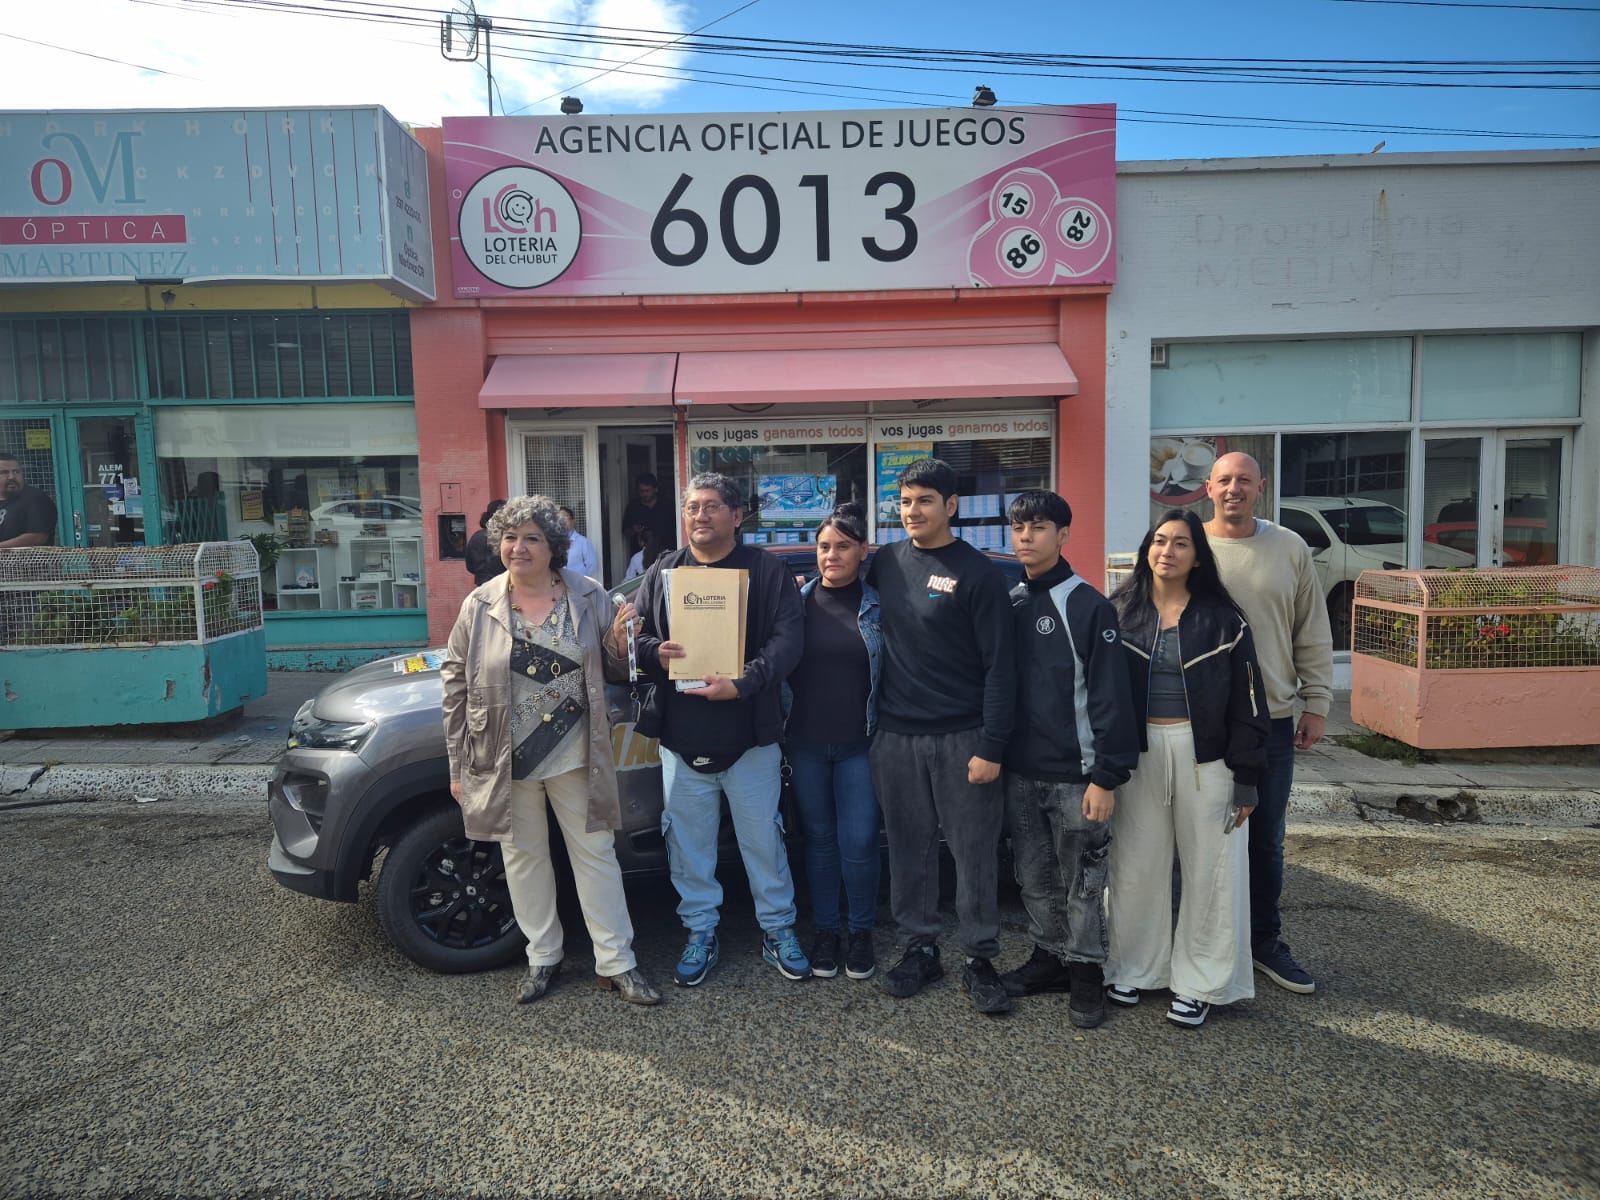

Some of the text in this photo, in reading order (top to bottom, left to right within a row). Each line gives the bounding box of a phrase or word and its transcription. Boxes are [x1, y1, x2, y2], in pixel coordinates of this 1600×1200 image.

[534, 116, 1026, 154] AGENCIA OFICIAL DE JUEGOS
[1000, 192, 1028, 216] 15
[22, 218, 166, 240] ÓPTICA
[650, 171, 919, 267] 6013
[1066, 210, 1091, 242] 28
[485, 237, 558, 253] LOTERIA
[1006, 234, 1041, 269] 86
[2, 251, 190, 278] MARTINEZ
[485, 254, 558, 265] DEL CHUBUT
[696, 425, 864, 443] vos jugas ganamos todos
[881, 418, 1049, 439] vos jugas ganamos todos
[98, 463, 123, 472] ALEM
[98, 473, 125, 485] 771
